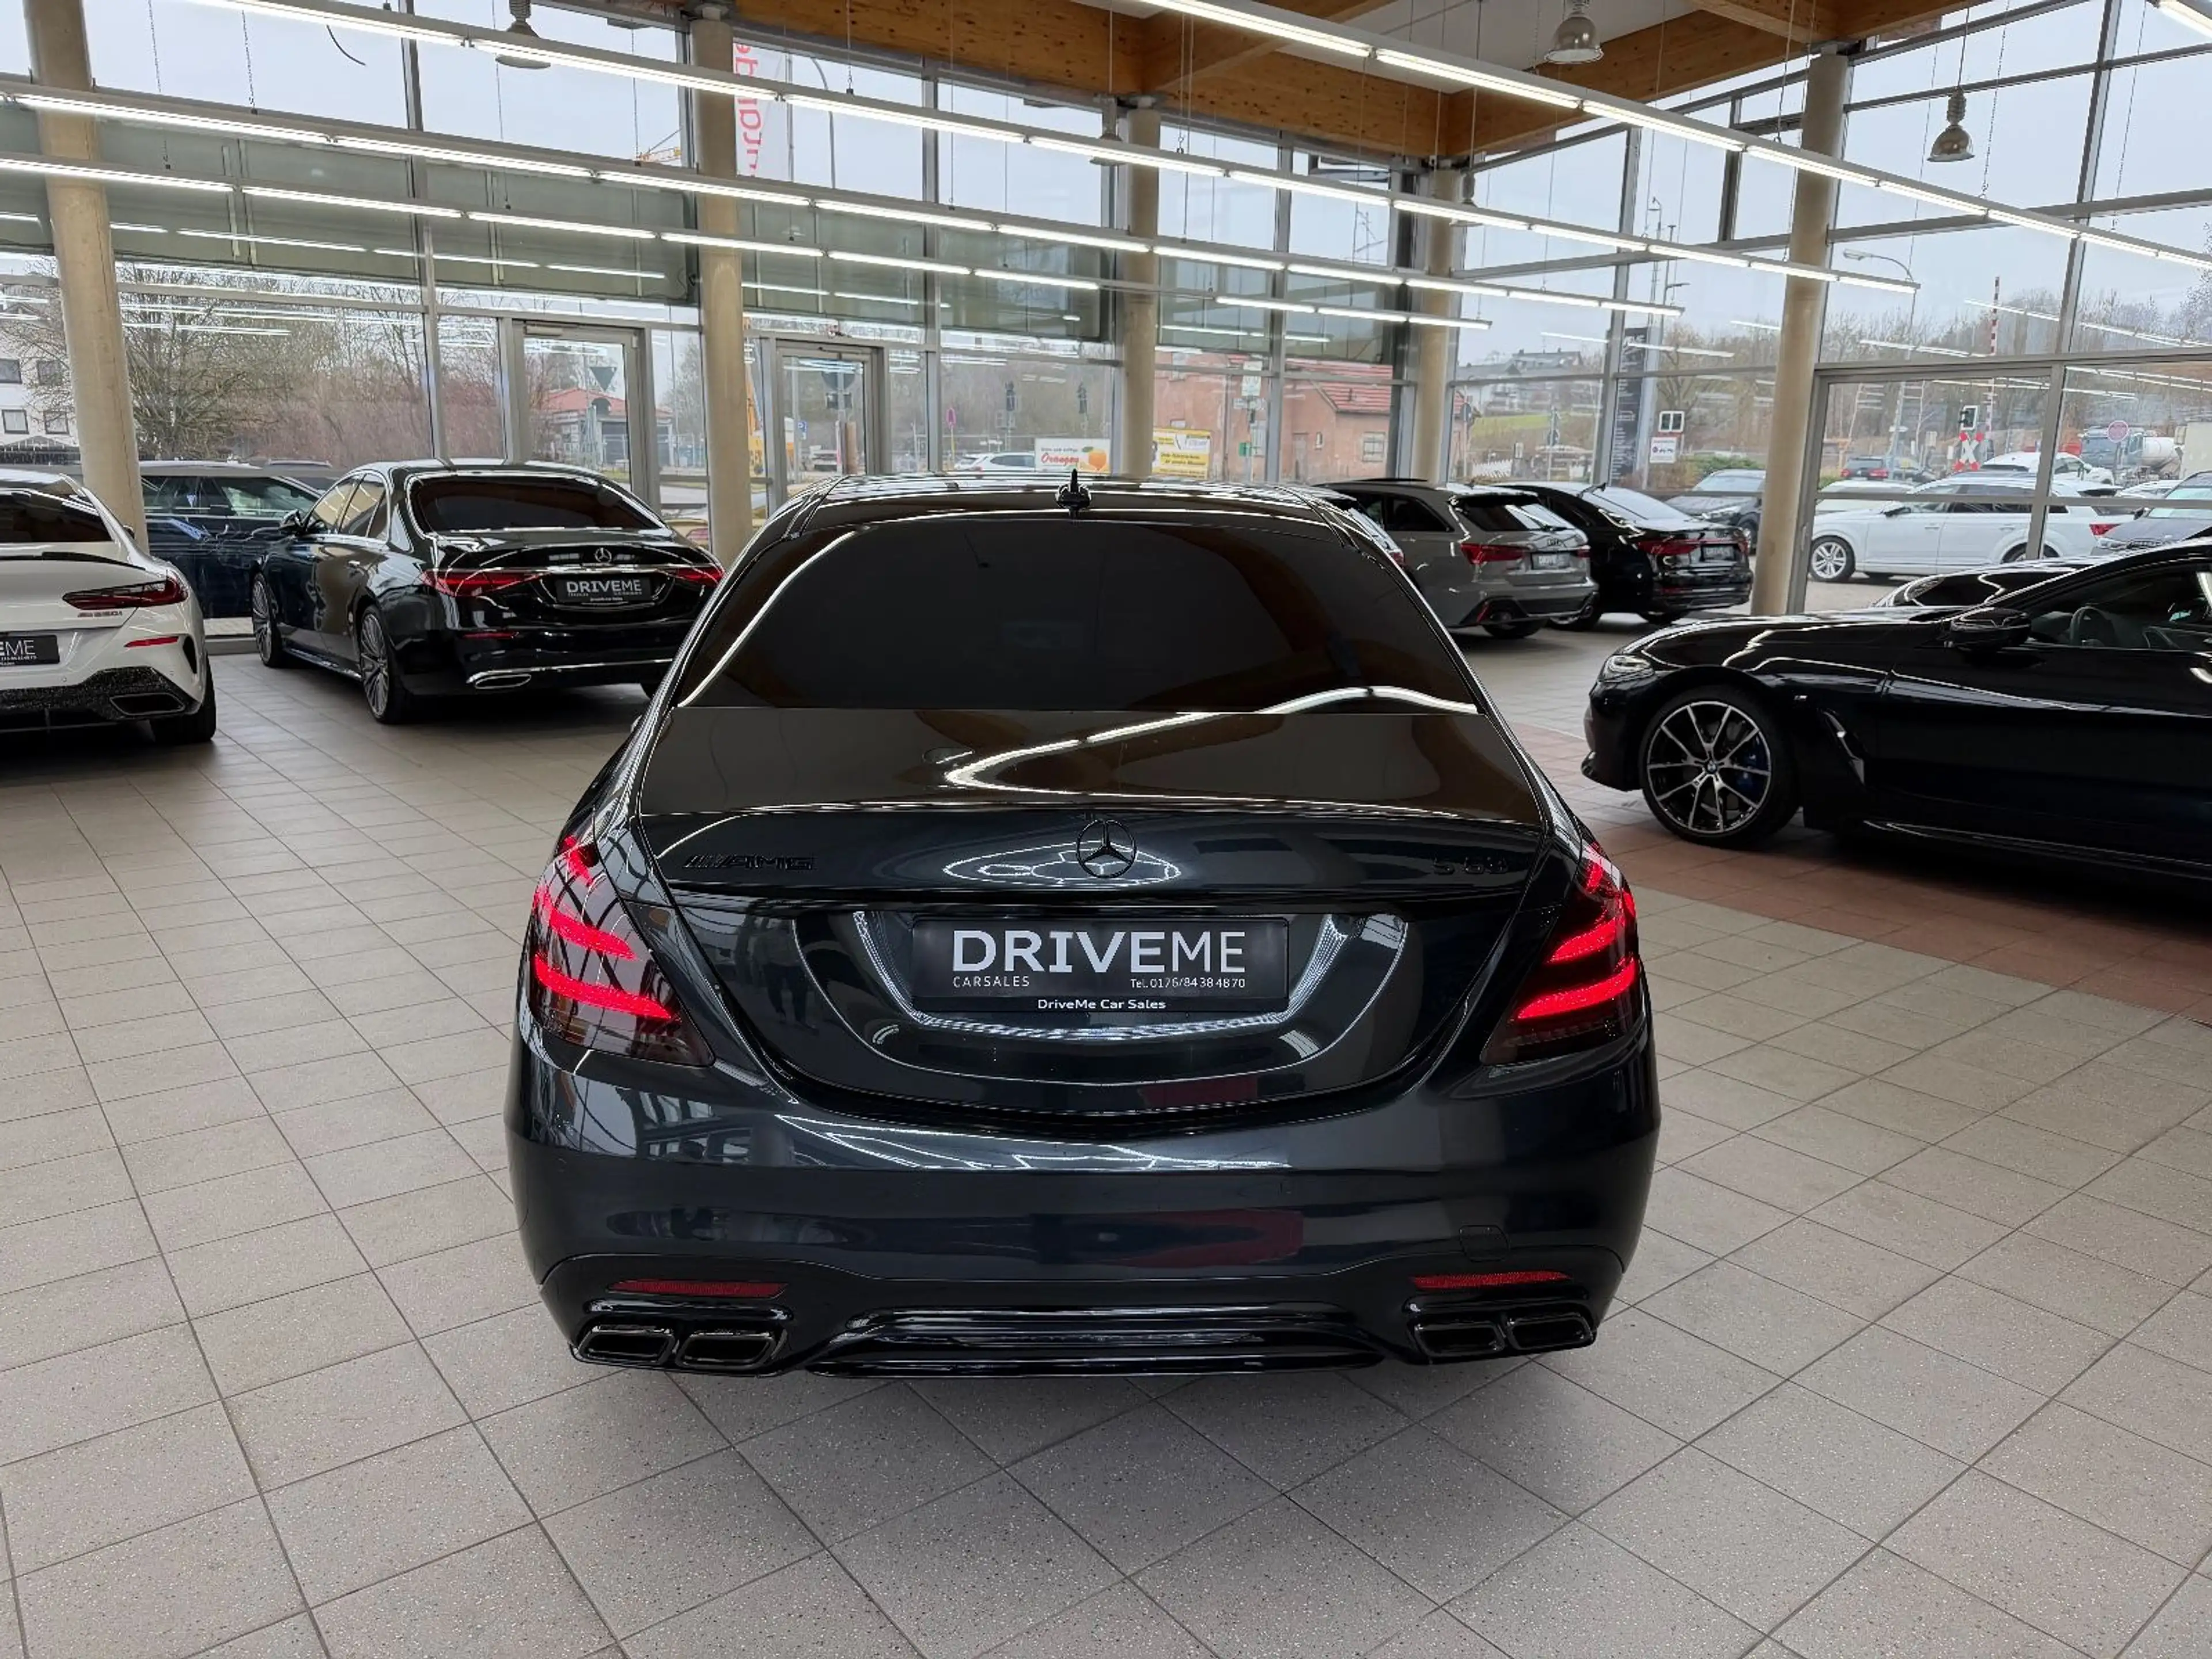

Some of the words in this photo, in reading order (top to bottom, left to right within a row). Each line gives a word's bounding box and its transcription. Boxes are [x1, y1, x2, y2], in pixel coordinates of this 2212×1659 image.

[566, 579, 642, 593] DRIVEME
[953, 930, 1245, 973] DRIVEME
[953, 976, 1030, 987] CARSALES
[1038, 999, 1096, 1009] DriveMe
[1100, 999, 1125, 1009] Car
[1128, 999, 1166, 1009] Sales
